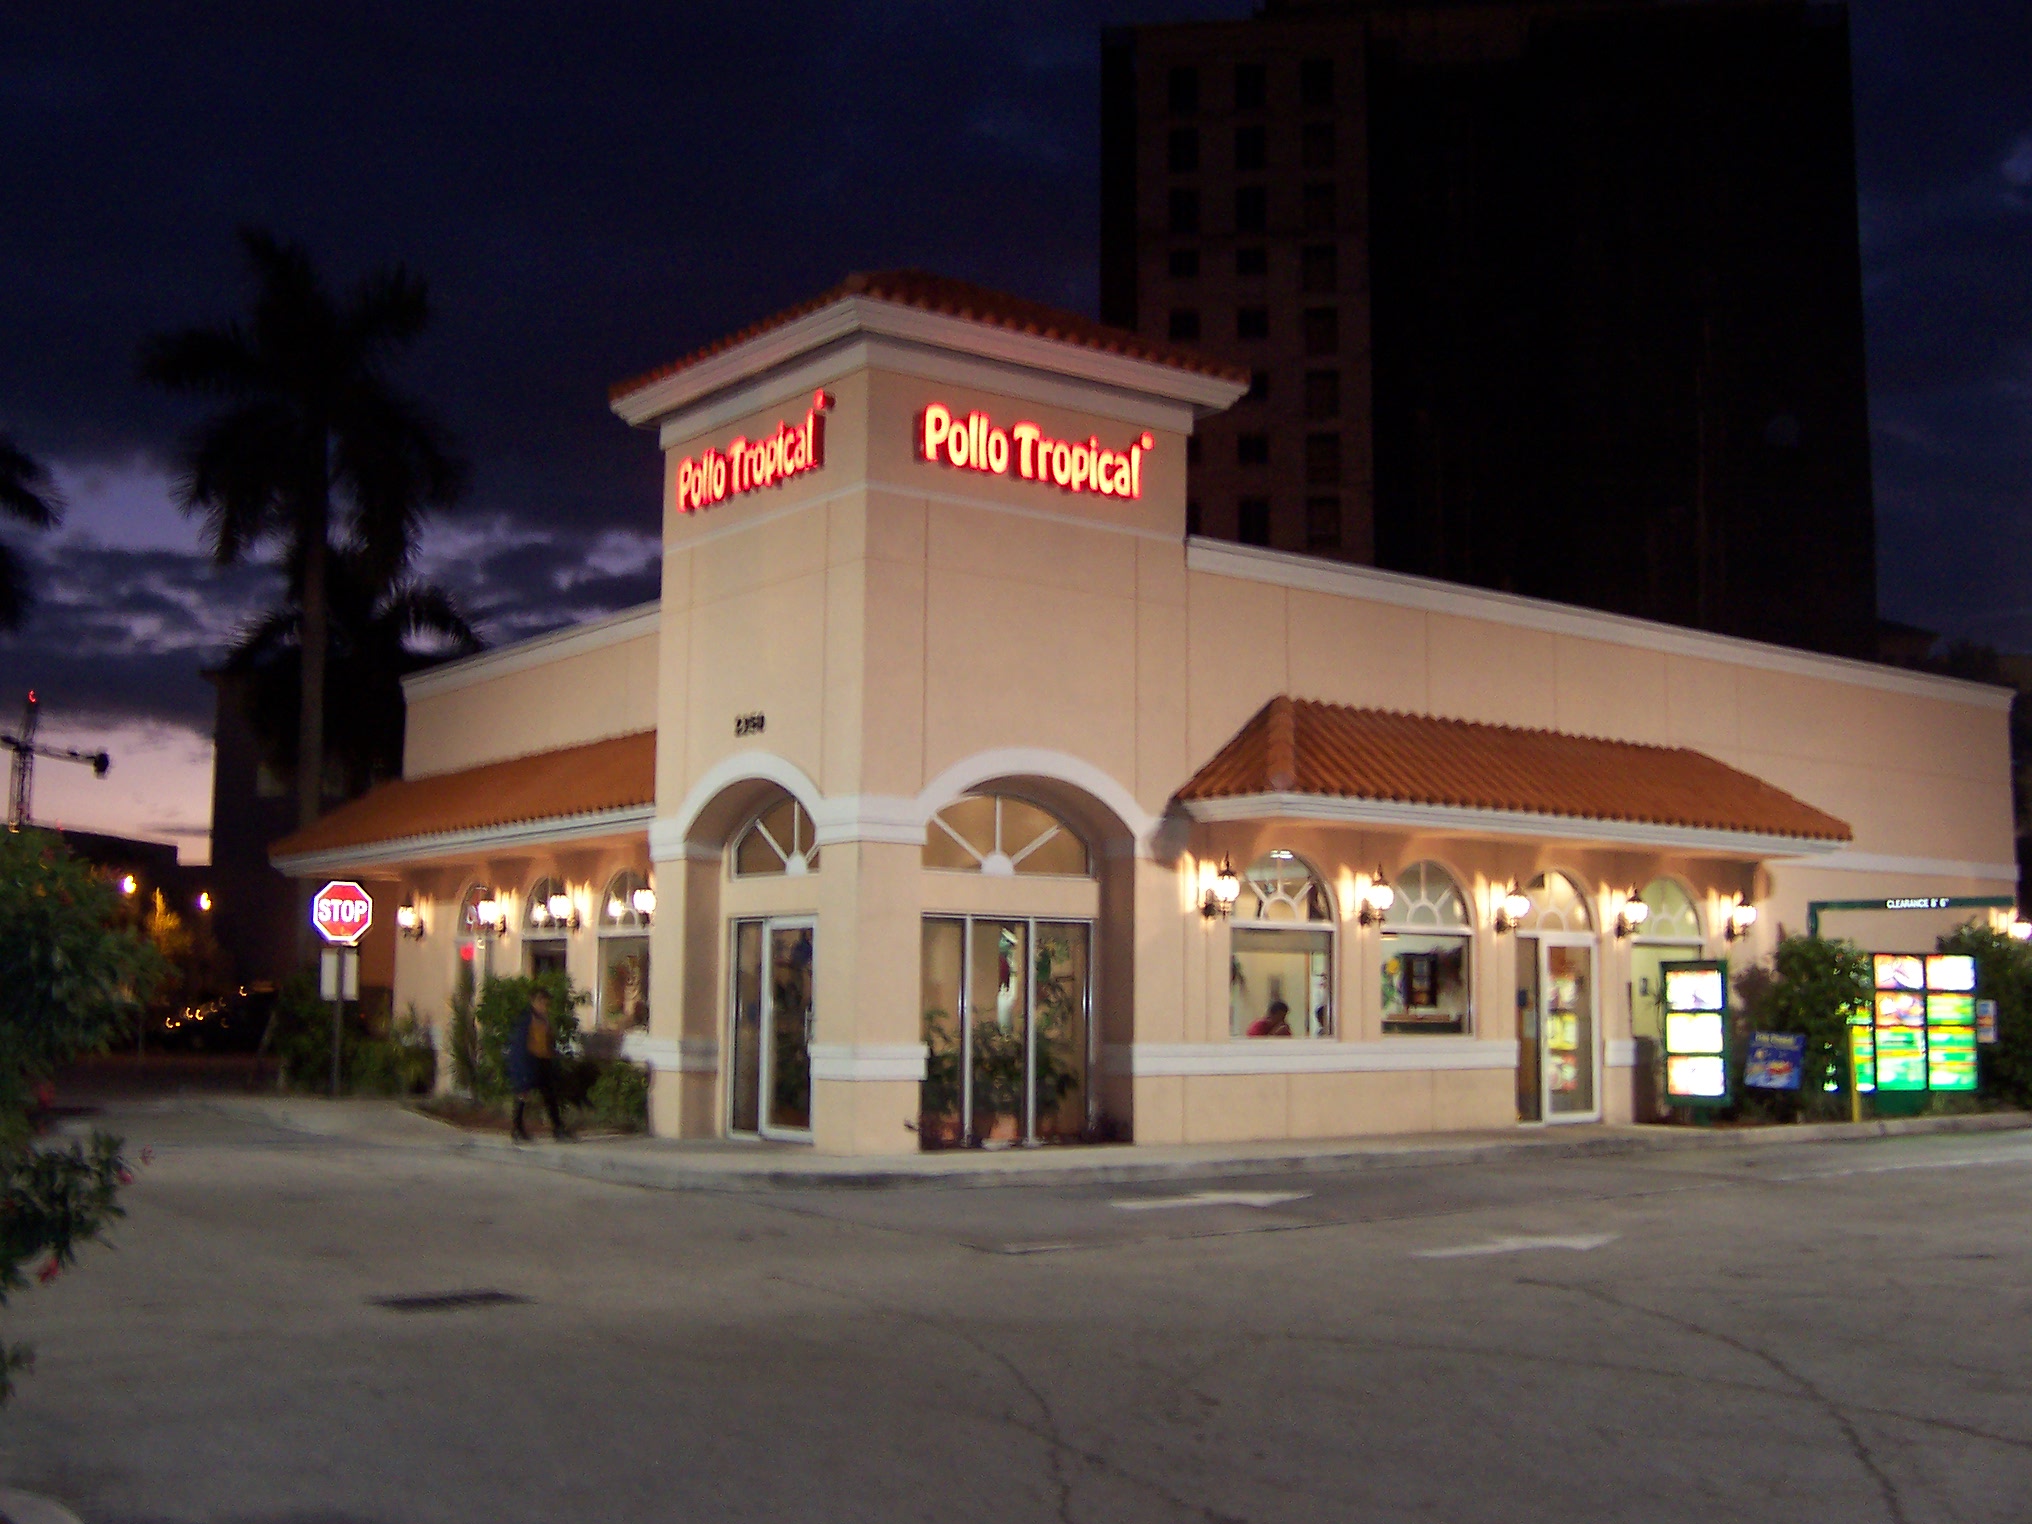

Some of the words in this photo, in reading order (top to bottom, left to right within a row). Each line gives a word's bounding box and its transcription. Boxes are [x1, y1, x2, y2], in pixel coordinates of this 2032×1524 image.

[676, 448, 727, 513] Pollo
[727, 407, 817, 494] Tropical
[922, 402, 1009, 474] Pollo
[1012, 420, 1142, 500] Tropical
[318, 898, 368, 923] STOP
[1886, 898, 1929, 909] CLEARANCE
